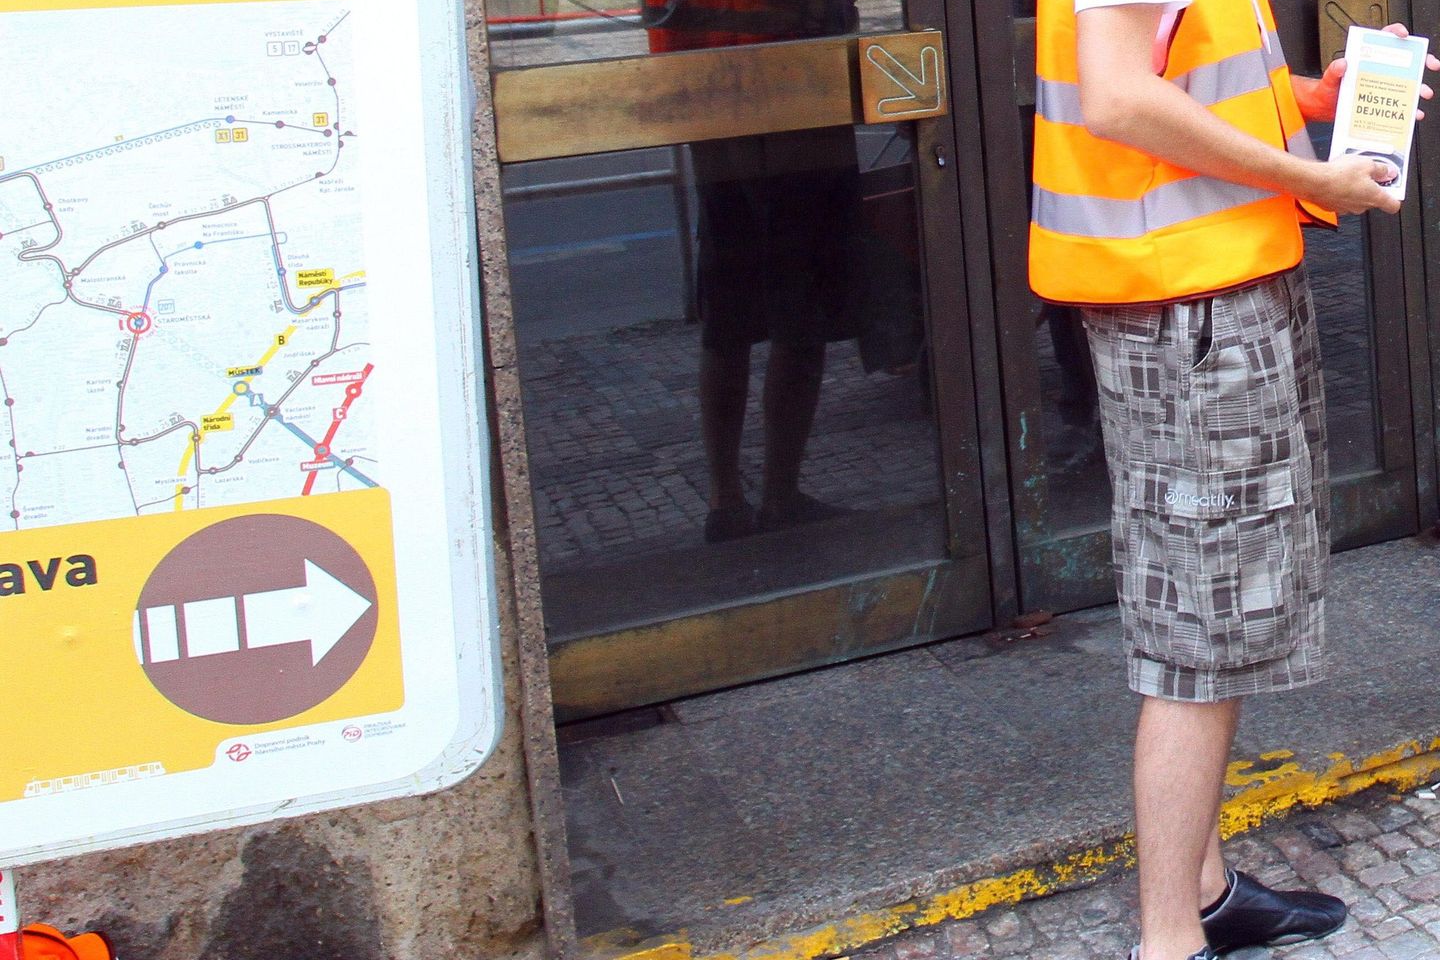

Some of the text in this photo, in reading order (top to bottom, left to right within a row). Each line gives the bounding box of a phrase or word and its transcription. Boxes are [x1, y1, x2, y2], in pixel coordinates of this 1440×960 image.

[1357, 91, 1400, 108] MŮSTEK
[1356, 105, 1405, 121] DEJVICKÁ
[278, 335, 285, 345] B
